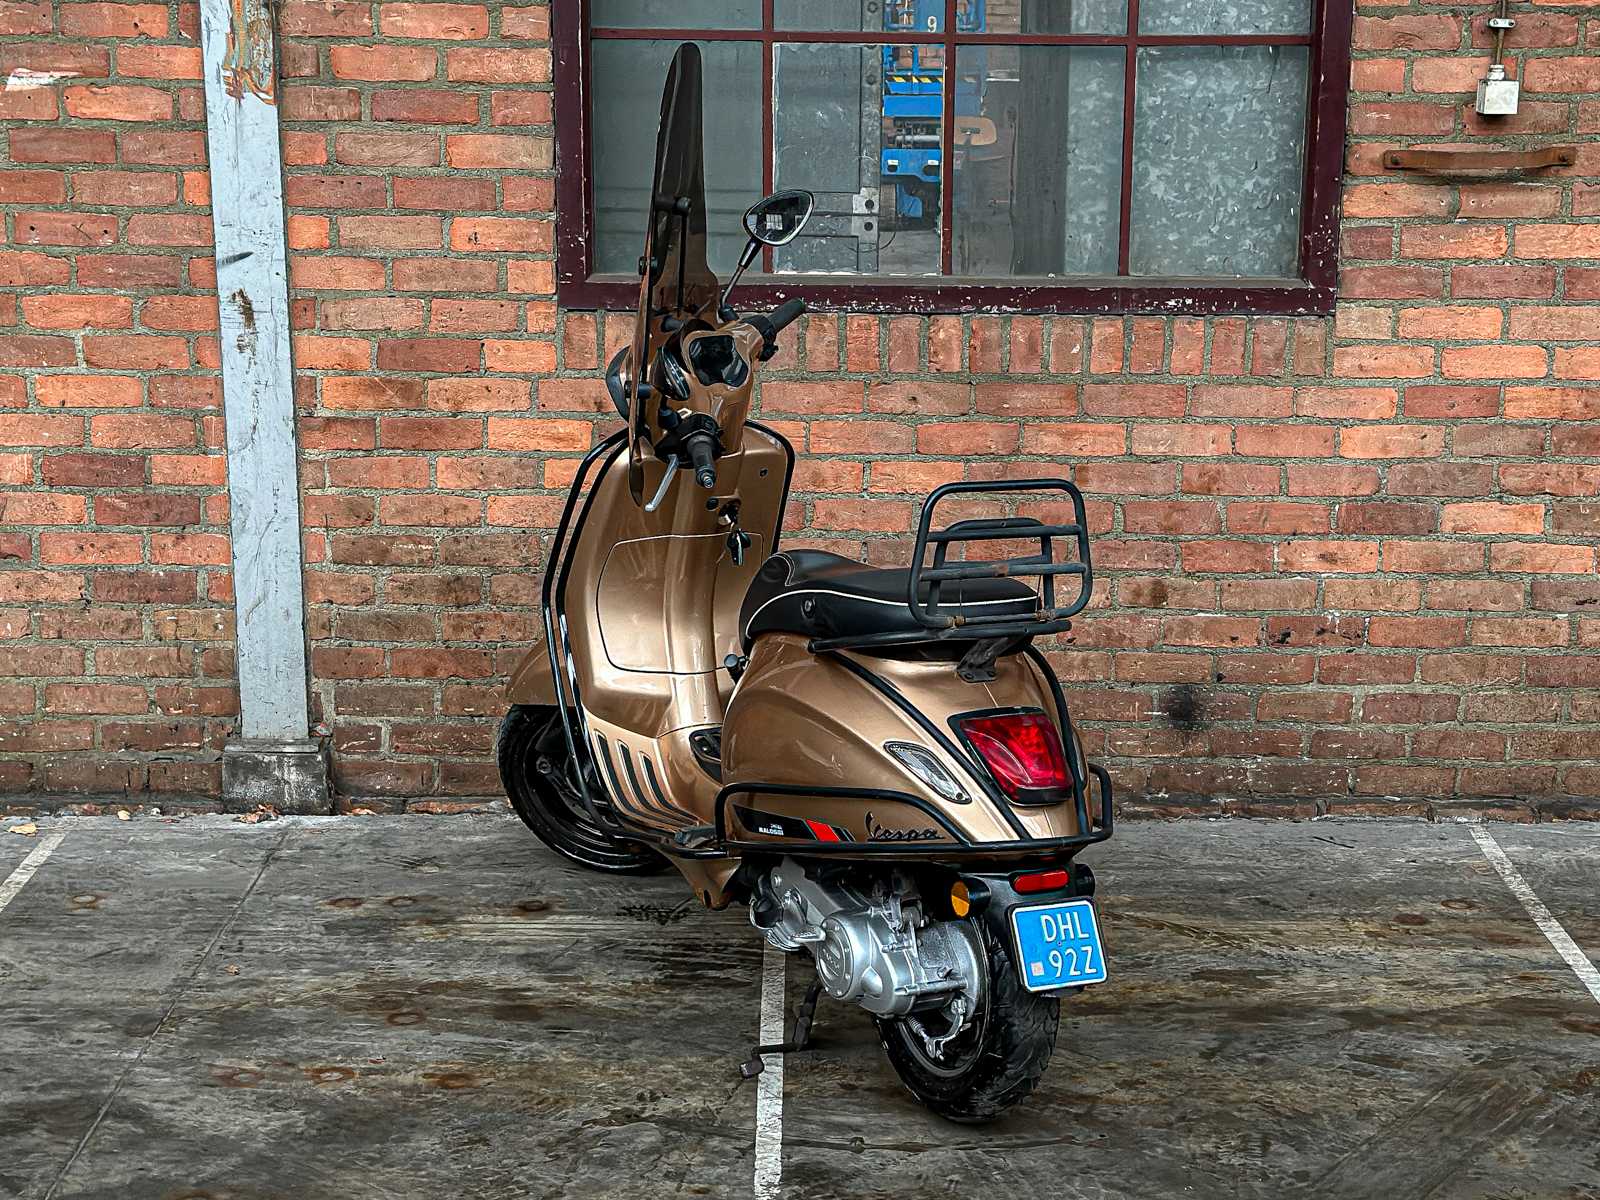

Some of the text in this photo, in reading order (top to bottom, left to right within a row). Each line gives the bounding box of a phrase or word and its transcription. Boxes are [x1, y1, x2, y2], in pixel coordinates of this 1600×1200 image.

[865, 811, 944, 842] Vespa
[1040, 911, 1090, 942] DHL
[1048, 945, 1097, 978] 92Z
